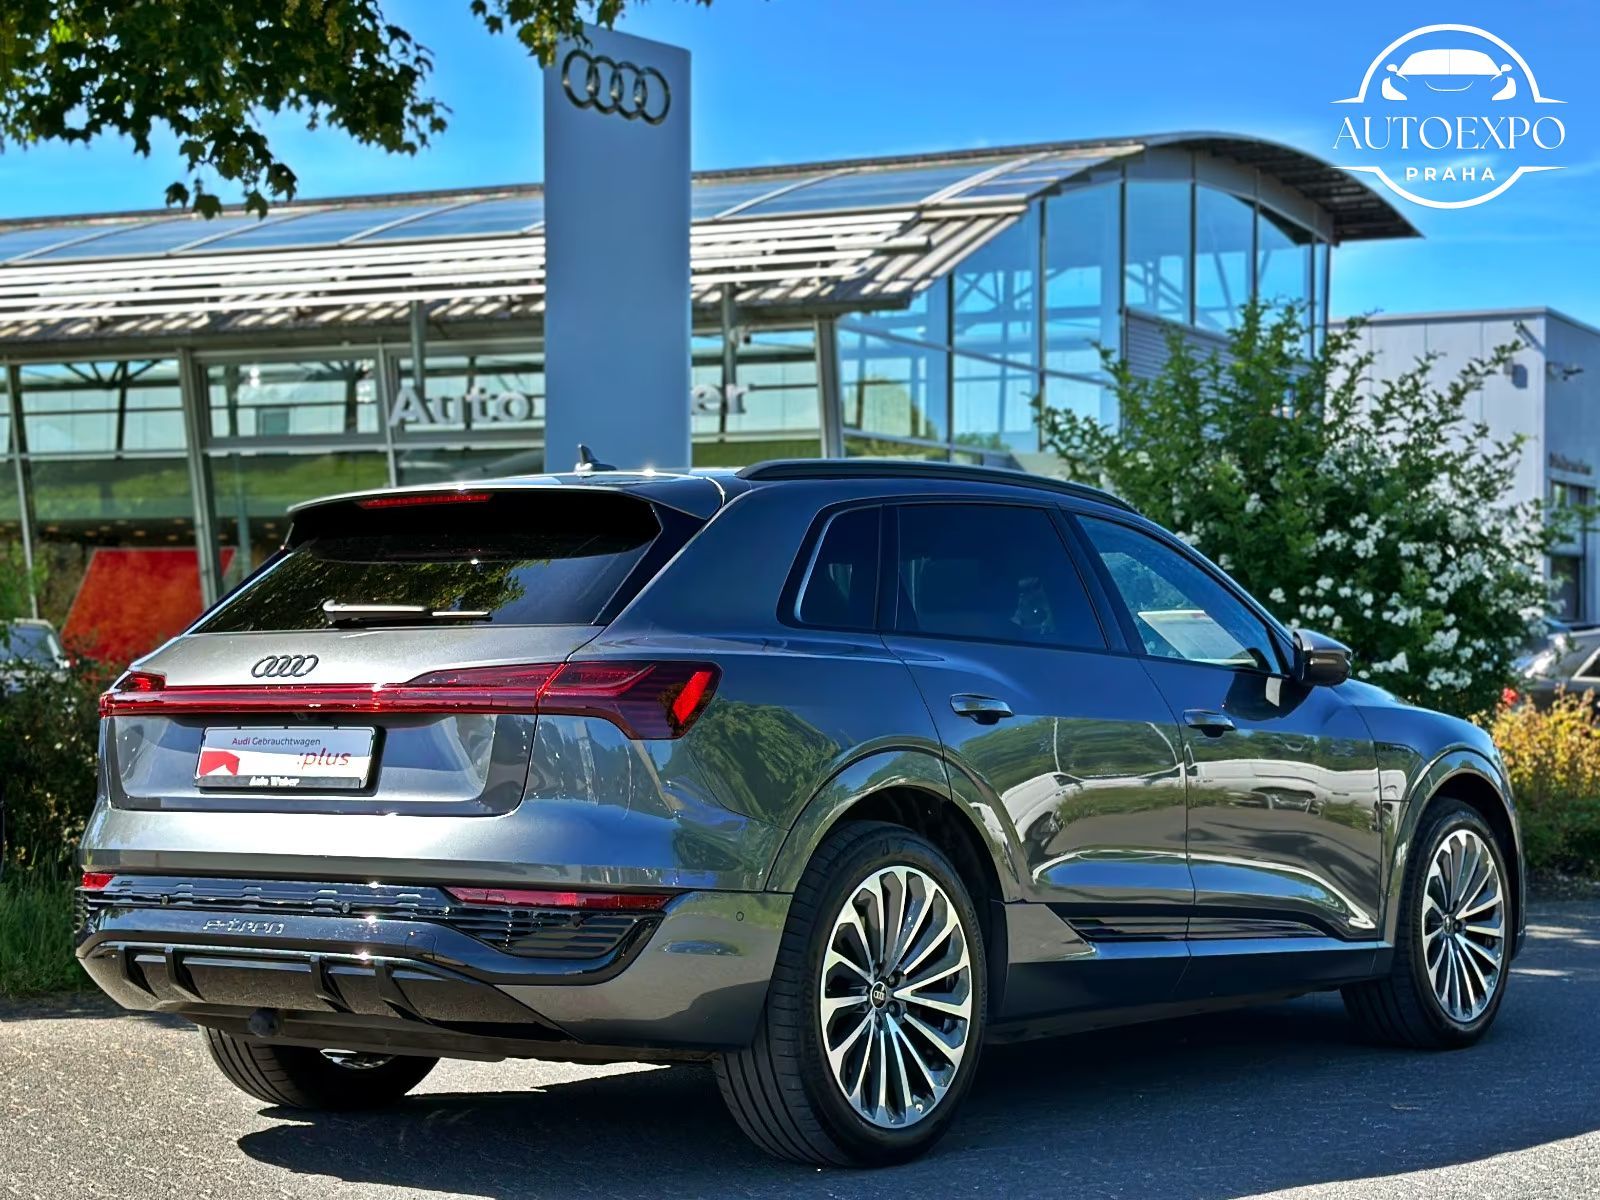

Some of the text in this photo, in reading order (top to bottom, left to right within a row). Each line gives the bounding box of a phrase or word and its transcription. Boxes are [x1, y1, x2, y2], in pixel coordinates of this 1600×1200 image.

[389, 383, 533, 428] Auto
[232, 737, 321, 747] Audi Gebrauchtwagen
